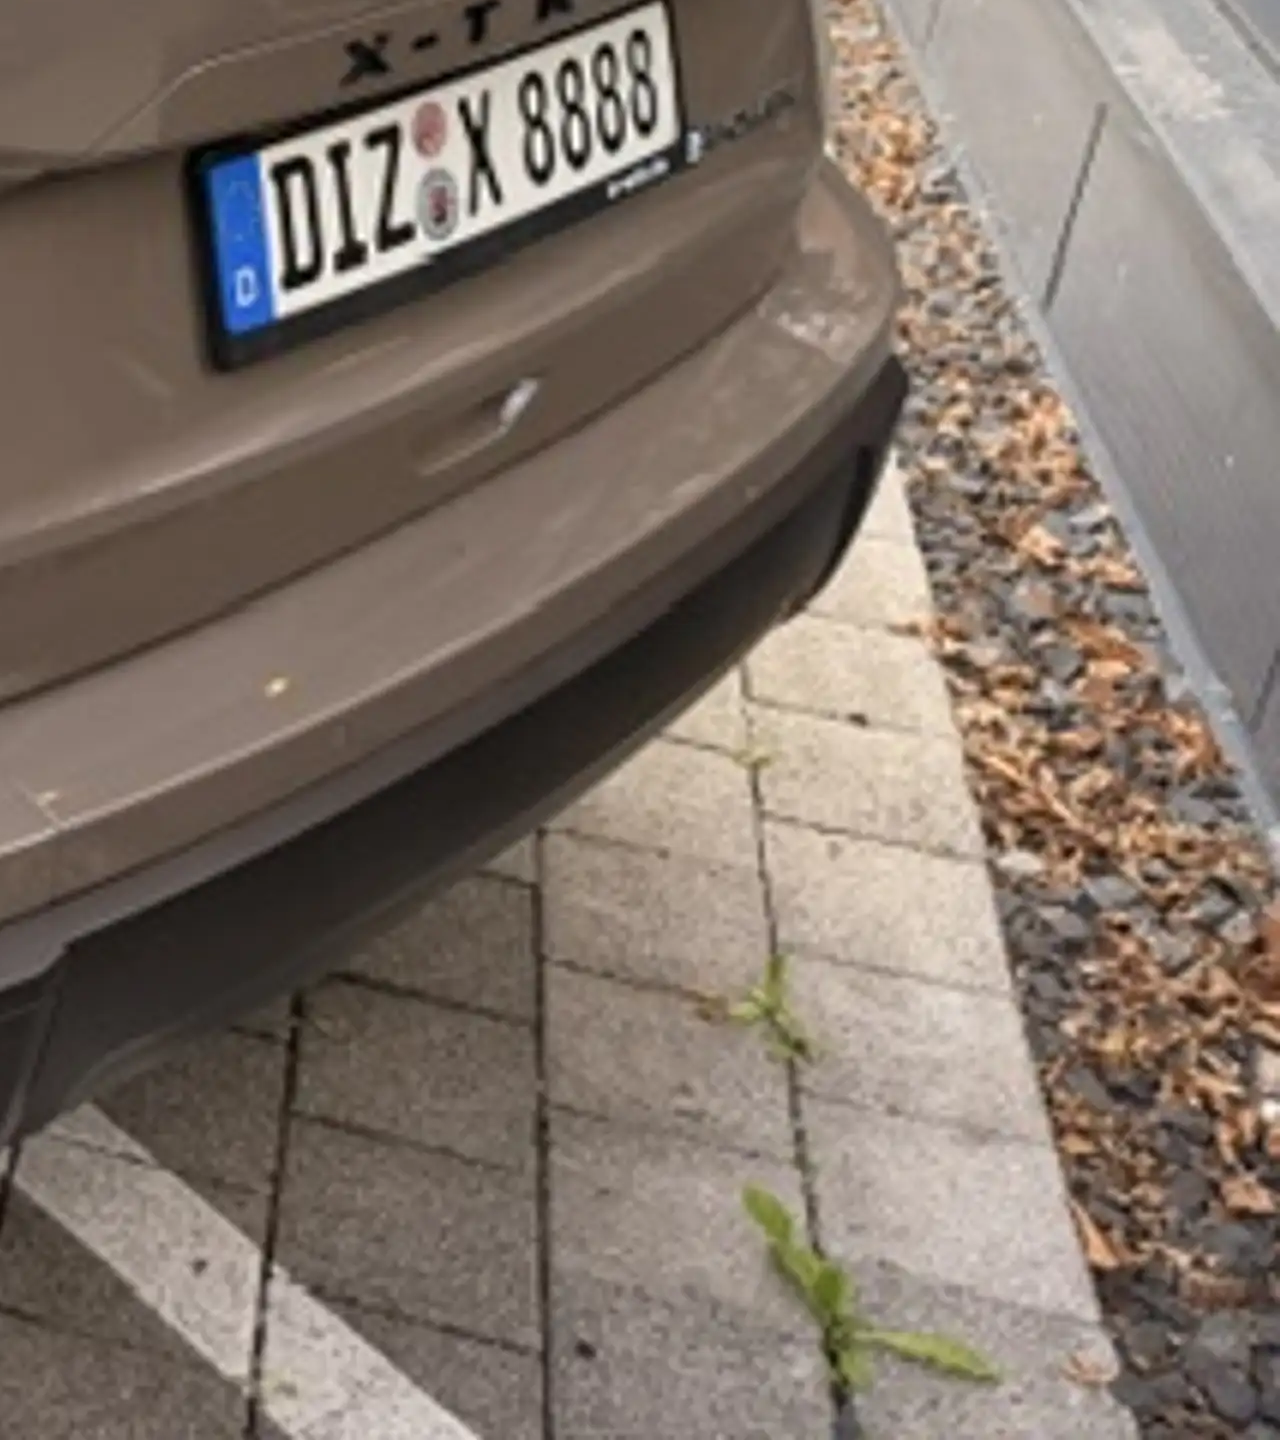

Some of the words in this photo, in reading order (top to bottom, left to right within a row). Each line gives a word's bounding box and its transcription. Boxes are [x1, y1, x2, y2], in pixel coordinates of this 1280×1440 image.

[271, 122, 417, 293] DIZ
[458, 89, 503, 217] X
[518, 28, 658, 187] 8888
[235, 265, 259, 308] D
